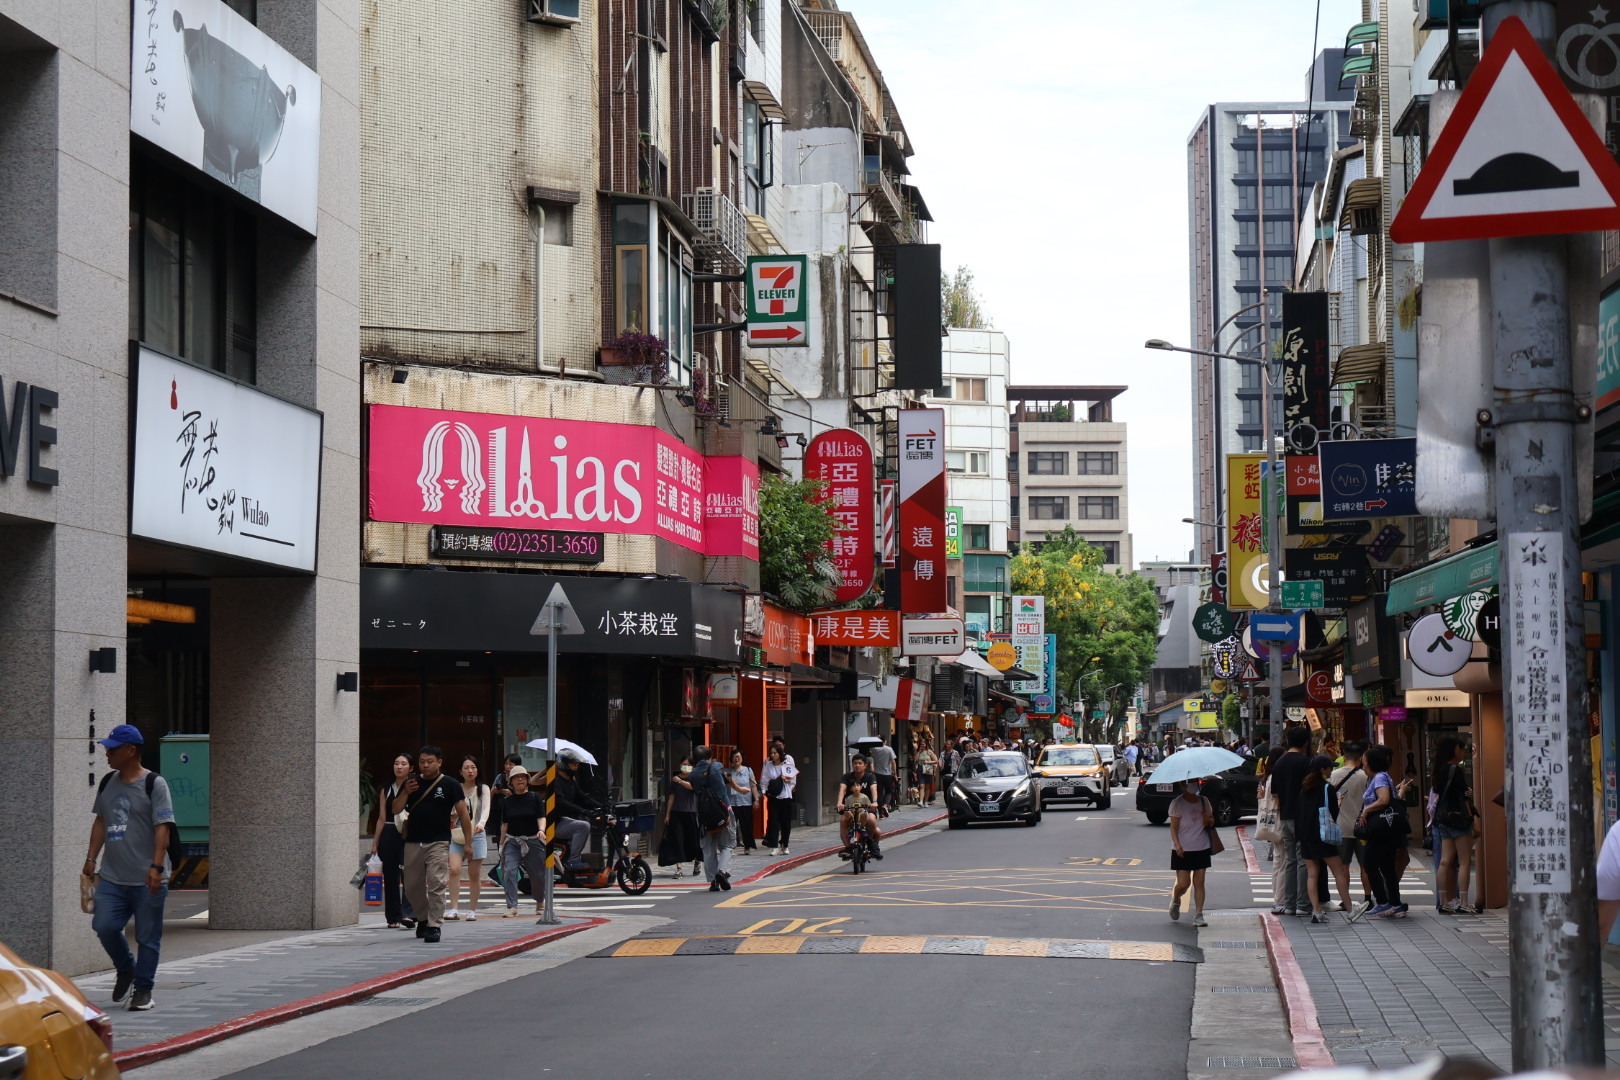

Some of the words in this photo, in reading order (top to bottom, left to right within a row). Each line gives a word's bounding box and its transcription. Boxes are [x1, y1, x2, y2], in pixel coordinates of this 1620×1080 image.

[759, 266, 794, 314] 7
[906, 438, 936, 450] FET
[1244, 463, 1261, 499] 彩虹
[241, 496, 269, 527] Wulao
[656, 479, 702, 524] 亞禮亞詩
[832, 462, 859, 556] 亞禮亞詩
[1333, 502, 1364, 512] 右轉2巷
[657, 513, 674, 532] ALLIAS
[1300, 518, 1324, 527] Nikon
[494, 531, 598, 556] (02)2351-3650
[913, 526, 933, 581] 遠傳
[1313, 552, 1340, 561] USAY
[1300, 591, 1305, 600] 2
[1531, 578, 1541, 640] 天上聖母
[597, 609, 679, 638] 小茶栽堂
[815, 615, 892, 640] 康是美
[1017, 622, 1040, 635] 出租
[935, 635, 959, 645] FET
[1517, 674, 1526, 741] 國泰民安
[1551, 674, 1561, 740] 風調雨順
[1524, 762, 1563, 776] 16:10
[1519, 801, 1528, 823] 平安
[1556, 801, 1567, 822] 合境
[1062, 856, 1144, 866] 20
[1533, 873, 1552, 886] 里
